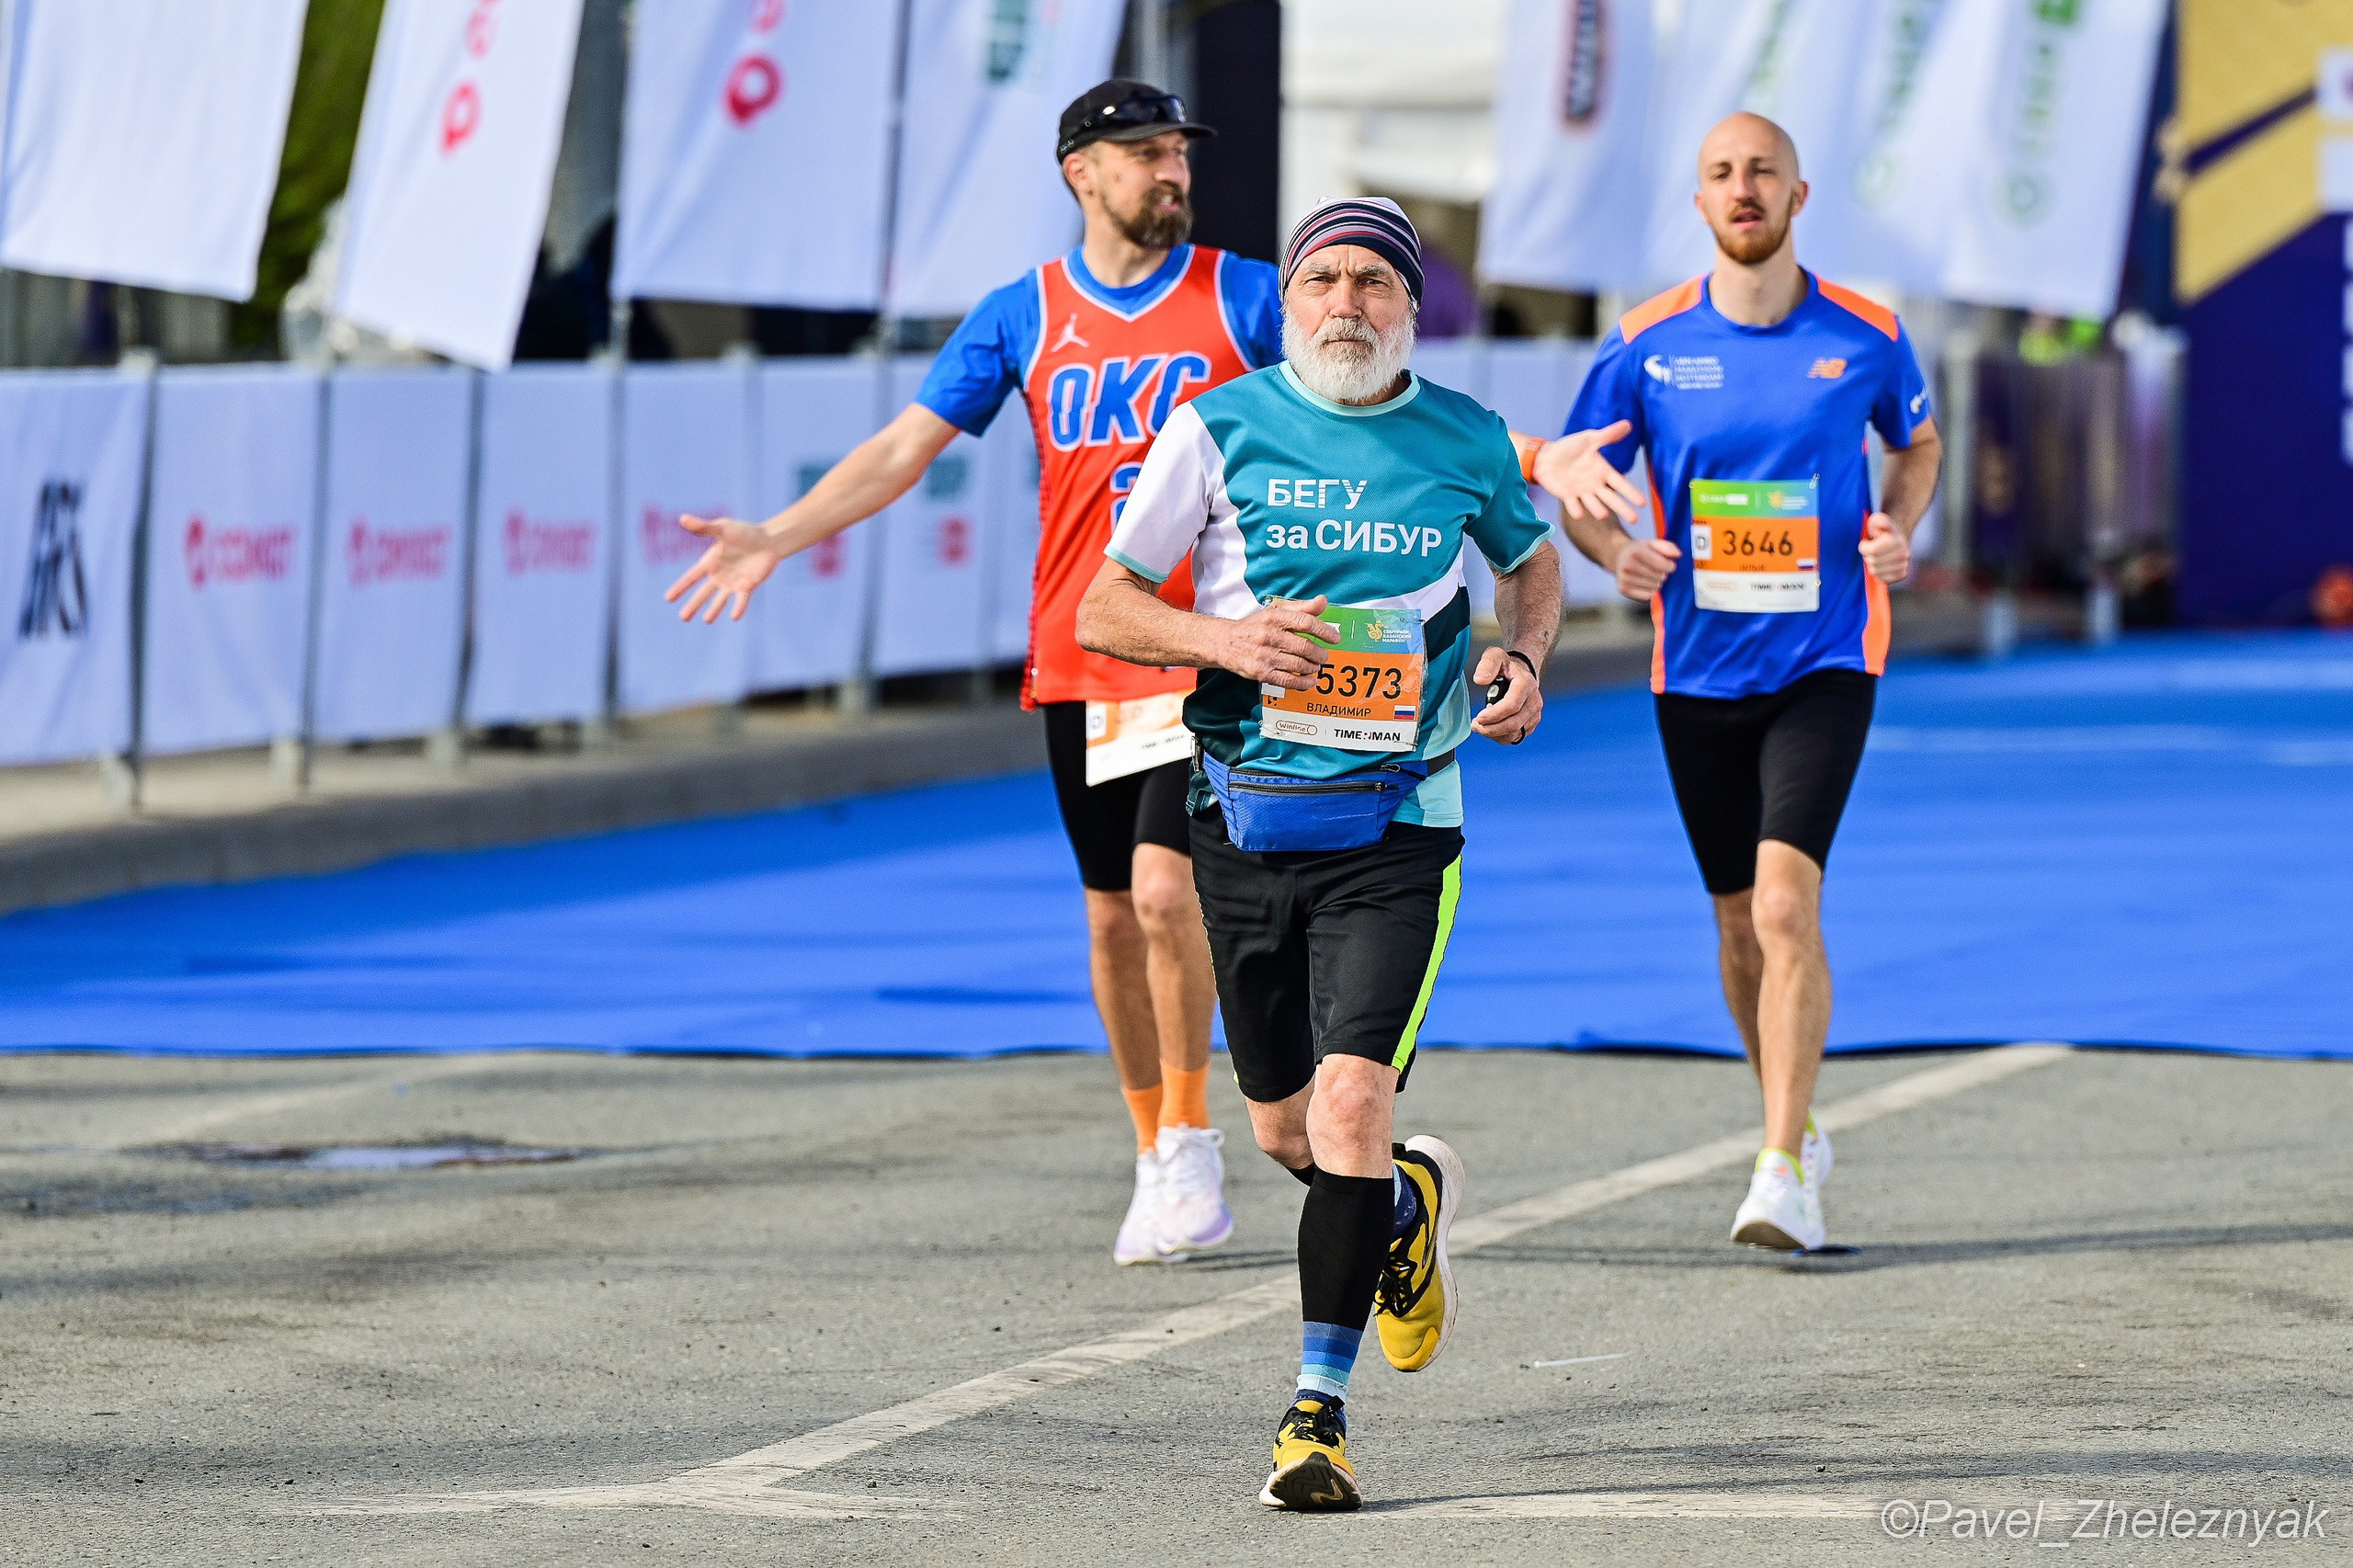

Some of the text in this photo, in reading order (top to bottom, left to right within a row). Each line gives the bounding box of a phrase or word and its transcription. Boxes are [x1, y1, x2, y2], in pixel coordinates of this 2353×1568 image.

[1047, 350, 1212, 452] OKC
[1267, 478, 1369, 510] БЕГУ
[1266, 520, 1442, 557] за СИБУР
[1722, 529, 1794, 556] 3646
[1306, 702, 1372, 718] ВЛАДИМИР
